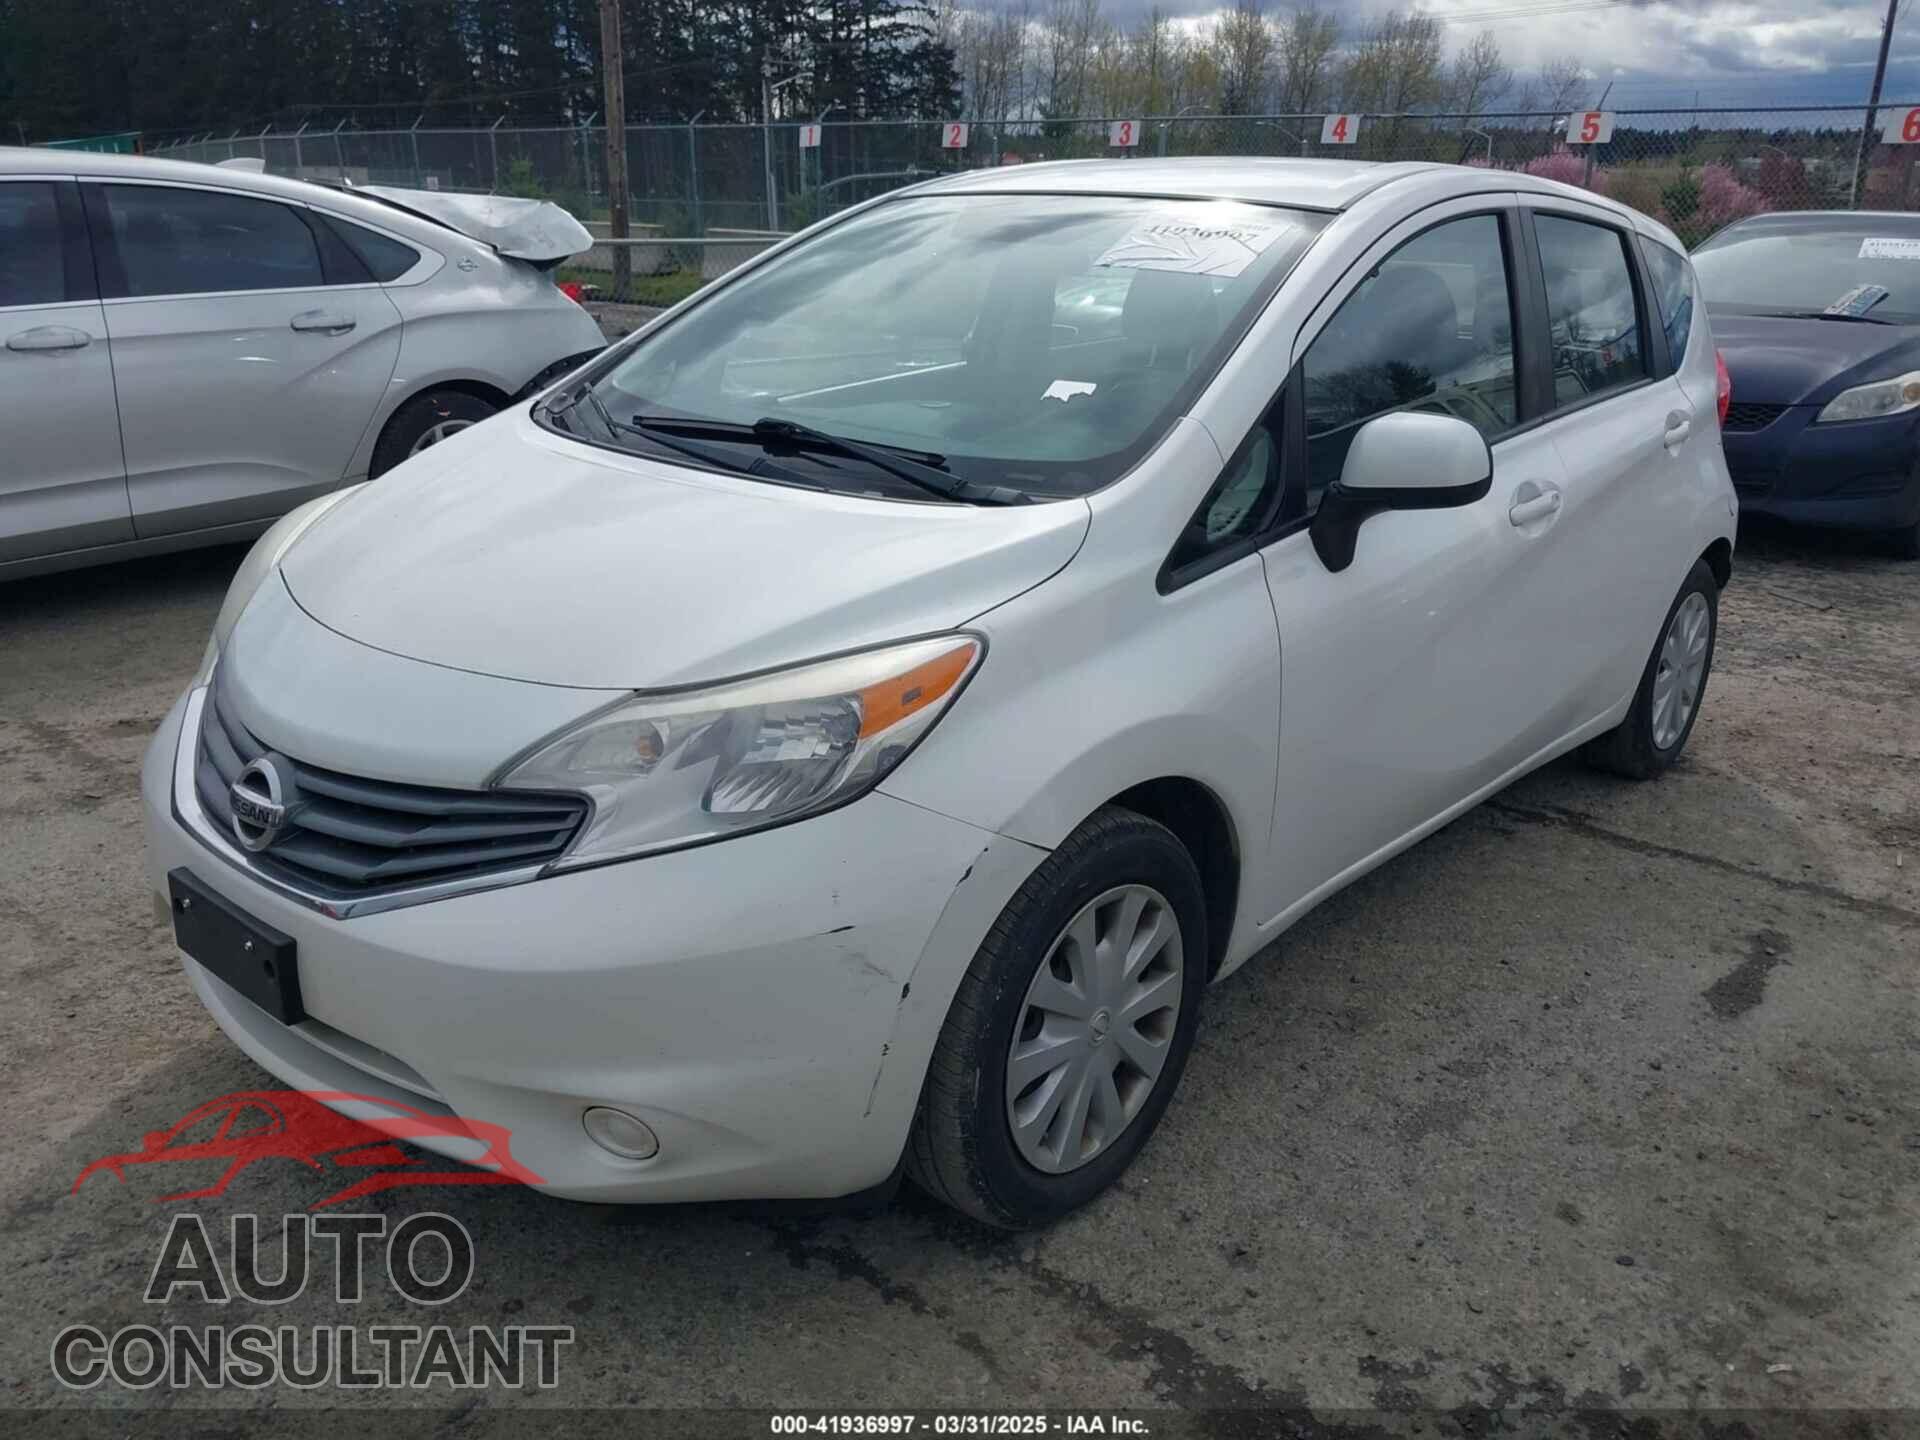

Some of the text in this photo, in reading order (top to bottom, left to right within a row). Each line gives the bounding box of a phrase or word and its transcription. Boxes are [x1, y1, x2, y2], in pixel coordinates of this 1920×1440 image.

[807, 127, 814, 145] 1
[950, 124, 961, 146] 2
[1118, 121, 1132, 145] 3
[1331, 115, 1348, 142] 4
[1580, 112, 1601, 142] 5
[1902, 107, 1920, 142] 6
